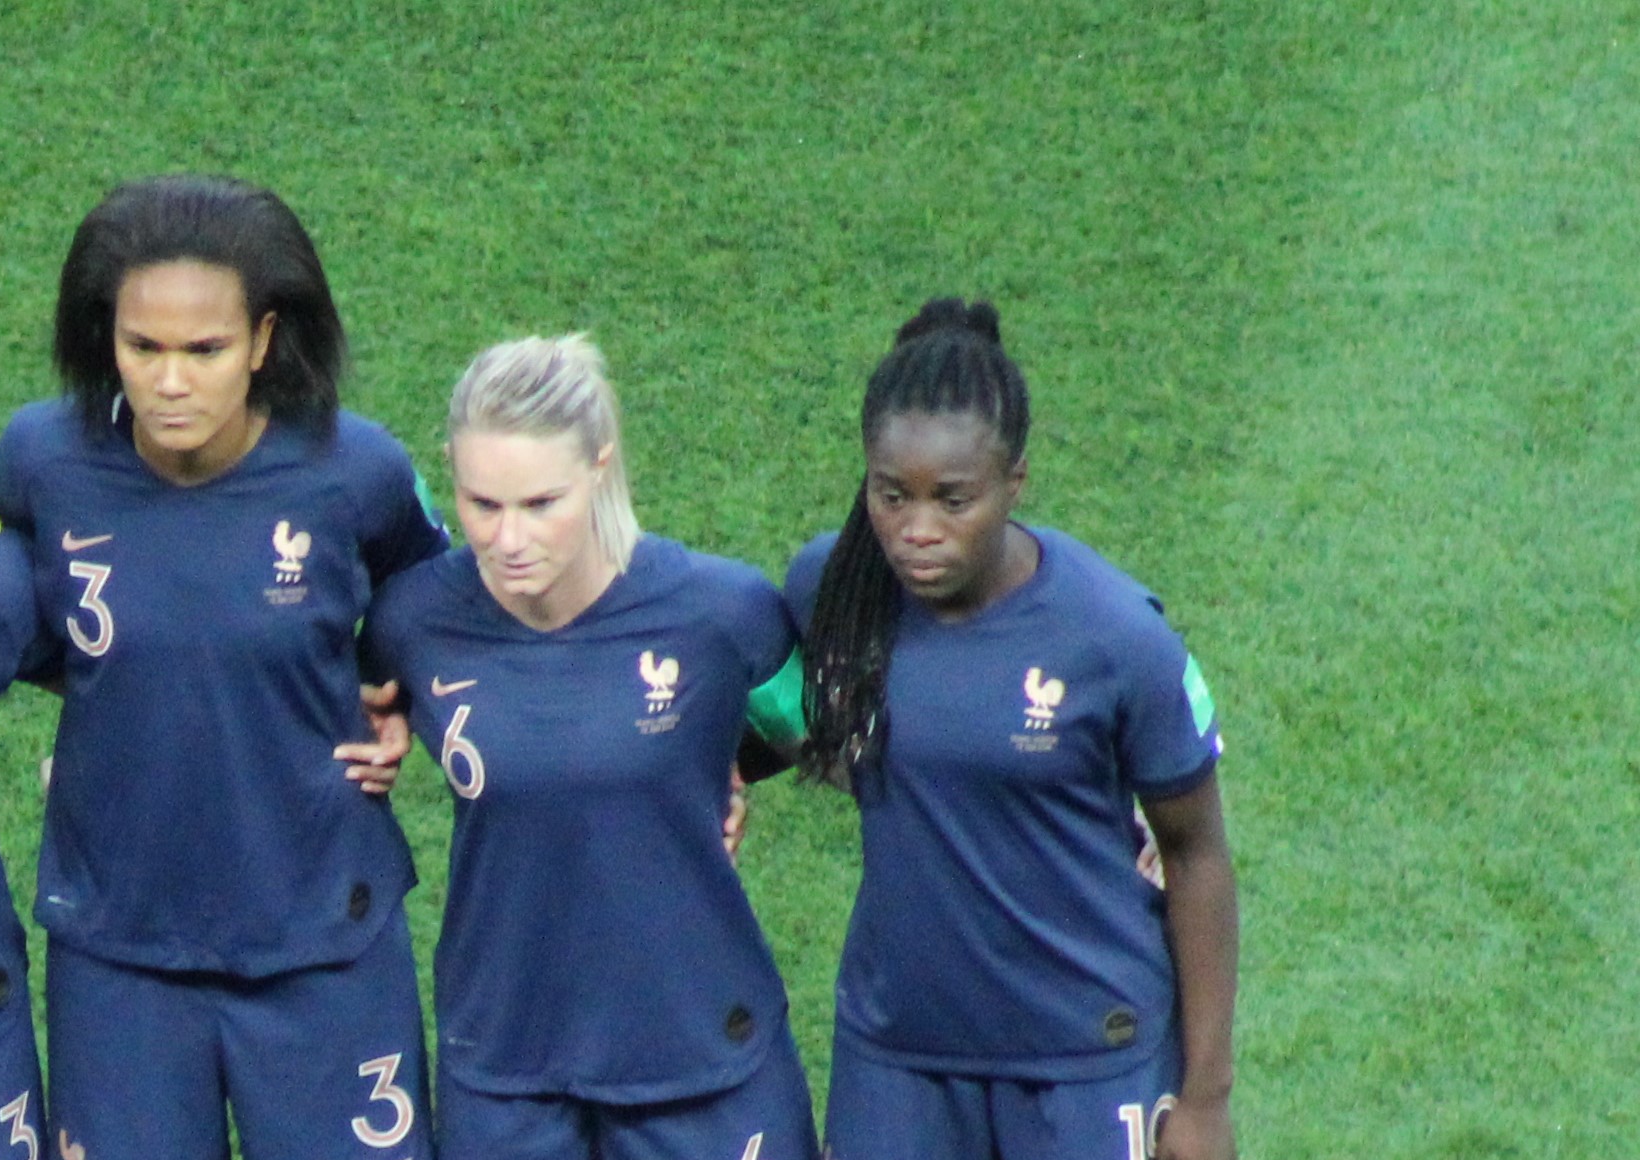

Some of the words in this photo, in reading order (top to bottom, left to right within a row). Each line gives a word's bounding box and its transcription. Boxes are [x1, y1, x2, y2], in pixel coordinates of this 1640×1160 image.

[66, 560, 114, 658] 3
[441, 704, 485, 800] 6
[350, 1051, 415, 1149] 3
